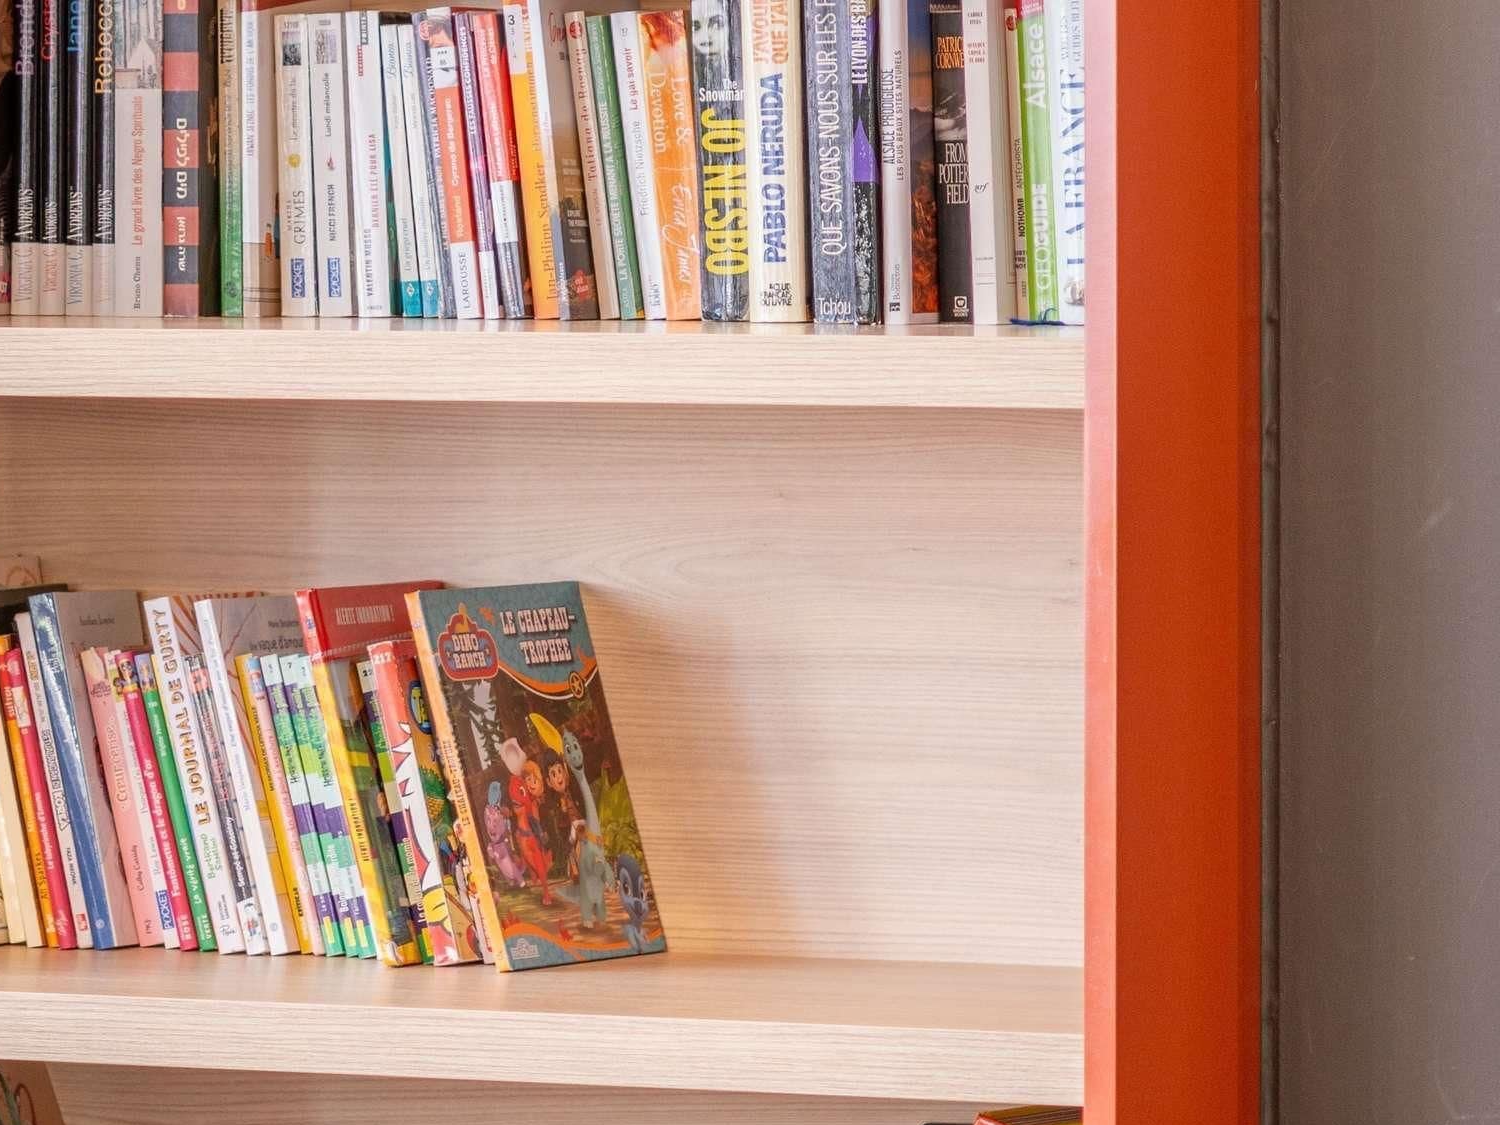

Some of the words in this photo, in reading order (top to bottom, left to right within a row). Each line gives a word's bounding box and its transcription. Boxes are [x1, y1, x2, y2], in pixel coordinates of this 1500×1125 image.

[814, 12, 837, 45] LES
[850, 14, 868, 39] DES
[459, 26, 471, 84] CONFIDENCES
[623, 47, 635, 78] savoir
[770, 30, 789, 65] QUE
[850, 40, 868, 70] LYON
[815, 51, 839, 85] SUR
[851, 71, 868, 85] LE
[893, 49, 903, 90] NATURELS
[1022, 23, 1046, 110] Alsace
[322, 72, 332, 114] mélancolie
[627, 80, 639, 97] gai
[628, 98, 638, 111] Le
[671, 76, 690, 122] Love
[880, 68, 895, 127] PRODIGIEUSE
[894, 91, 903, 114] SITES
[131, 95, 145, 137] Spirituals
[324, 115, 333, 138] Lundi
[444, 97, 455, 138] Bergerac
[468, 119, 477, 135] LES
[649, 71, 668, 154] Devotion
[760, 72, 786, 177] NERUDA
[174, 117, 189, 168] לפילים
[368, 133, 376, 152] LISA
[632, 120, 646, 170] Nietzsche
[677, 127, 692, 147] &
[700, 107, 746, 154] JO
[895, 117, 903, 143] BEAUX
[131, 139, 145, 166] Negro
[585, 128, 598, 182] Tatiana
[816, 89, 844, 213] SAVONS-NOUS
[881, 130, 896, 165] ALSACE
[895, 144, 904, 165] PLUS
[131, 168, 142, 184] des
[176, 171, 188, 199] מים
[450, 153, 461, 187] Cyrano
[896, 167, 905, 181] LES
[131, 184, 143, 206] livre
[326, 184, 335, 218] FRENCH
[534, 162, 549, 219] Sendker
[635, 172, 649, 216] Friedrich
[671, 183, 691, 228] Erica
[13, 189, 34, 240] ANDREWS
[42, 200, 58, 242] ANDREWS
[66, 191, 84, 241] ANDREWS
[95, 189, 113, 240] ANDREWS
[131, 207, 145, 233] grand
[292, 190, 306, 245] GRIMES
[452, 195, 464, 237] Rostand
[761, 183, 788, 264] PABLO
[1016, 197, 1026, 237] NOTHOMB
[132, 234, 143, 246] Le
[617, 239, 627, 267] PORTE
[820, 220, 848, 255] QUE
[292, 259, 304, 298] POCKET
[328, 258, 340, 297] POCKET
[458, 252, 472, 310] LAROUSSE
[619, 266, 629, 281] LA
[133, 284, 141, 310] Bruno
[814, 296, 851, 316] Tchou
[500, 611, 517, 635] LE
[517, 606, 576, 634] CHAPEAU-
[151, 607, 179, 675] GURTY
[451, 634, 479, 652] DINO
[519, 632, 572, 665] TROPHÉE
[372, 653, 393, 665] 217
[453, 652, 487, 669] RANCH
[167, 677, 185, 705] DE
[143, 757, 156, 780] d'or
[175, 707, 205, 797] JOURNAL
[148, 780, 164, 816] dragon
[194, 801, 211, 826] LE
[157, 817, 167, 828] le
[34, 851, 47, 885] Sparkes
[162, 841, 181, 897] Fantômette
[156, 889, 173, 929] POCKET
[181, 913, 192, 940] ROSE
[201, 913, 213, 940] VERTE
